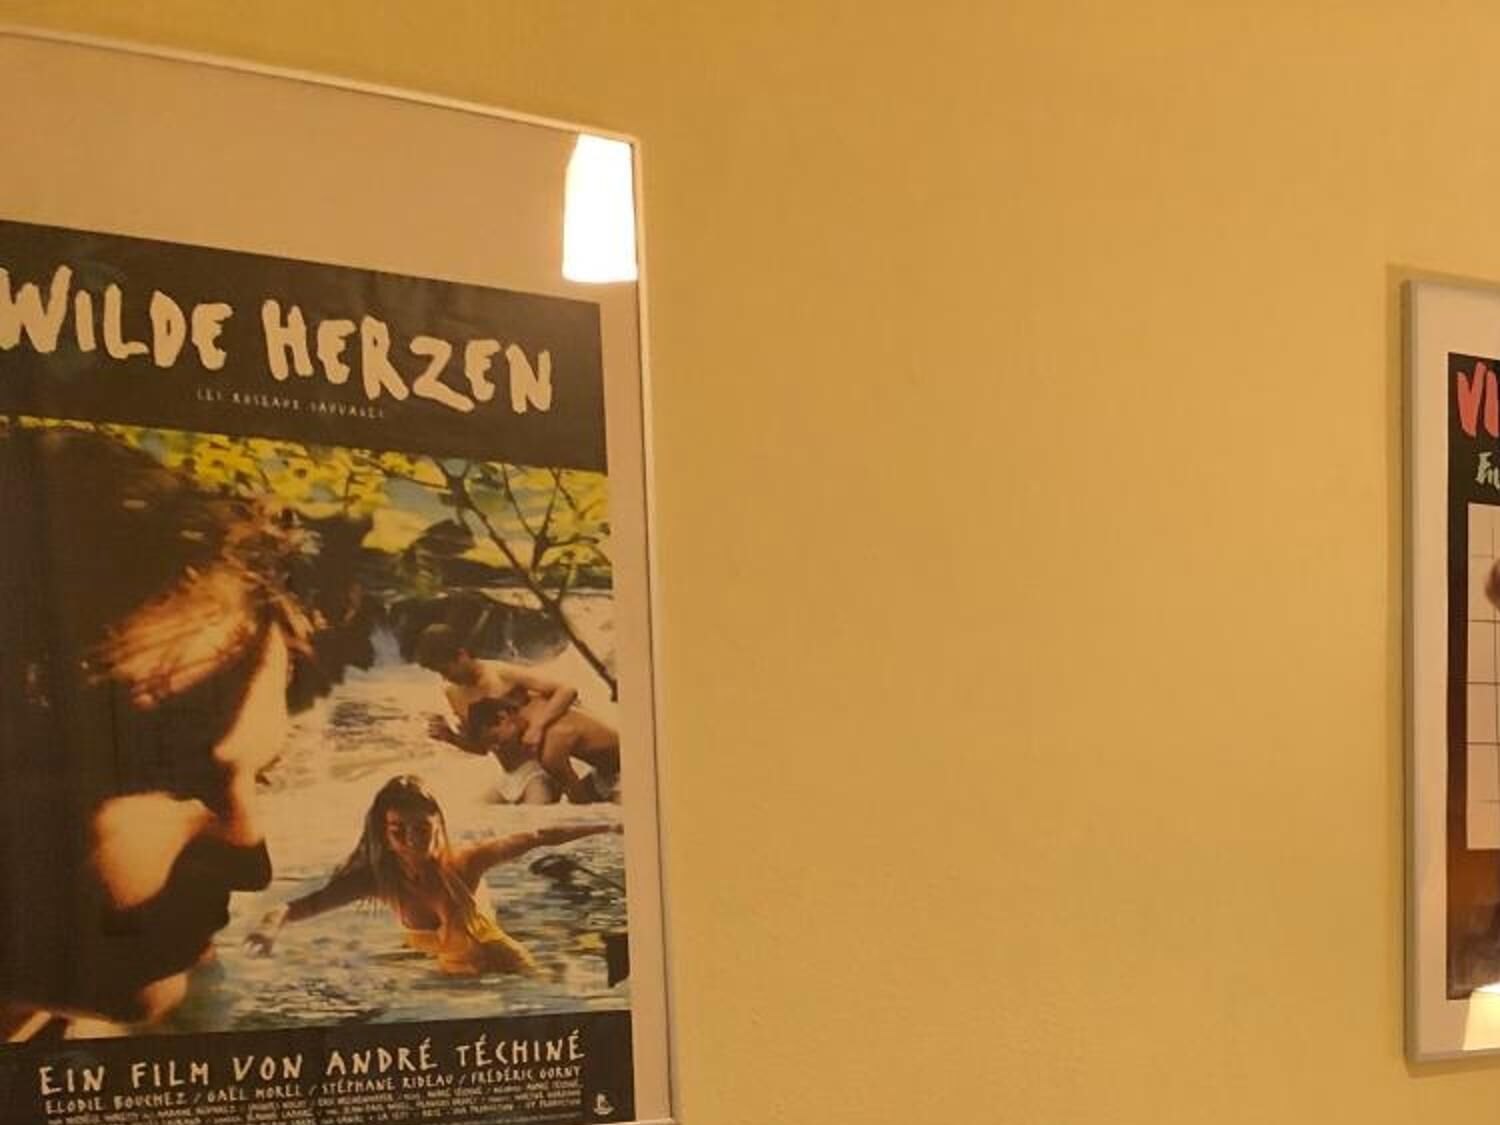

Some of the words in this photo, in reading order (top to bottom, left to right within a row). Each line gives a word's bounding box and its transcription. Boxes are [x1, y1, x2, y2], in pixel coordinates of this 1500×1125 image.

[0, 265, 233, 370] WILDE
[262, 300, 553, 413] HERZEN
[1457, 361, 1499, 438] VI
[39, 1065, 105, 1095] EIN
[131, 1060, 209, 1089] FILM
[232, 1053, 304, 1082] VON
[326, 1036, 438, 1076] ANDRÉ
[456, 1029, 586, 1068] TÉCHINÉ
